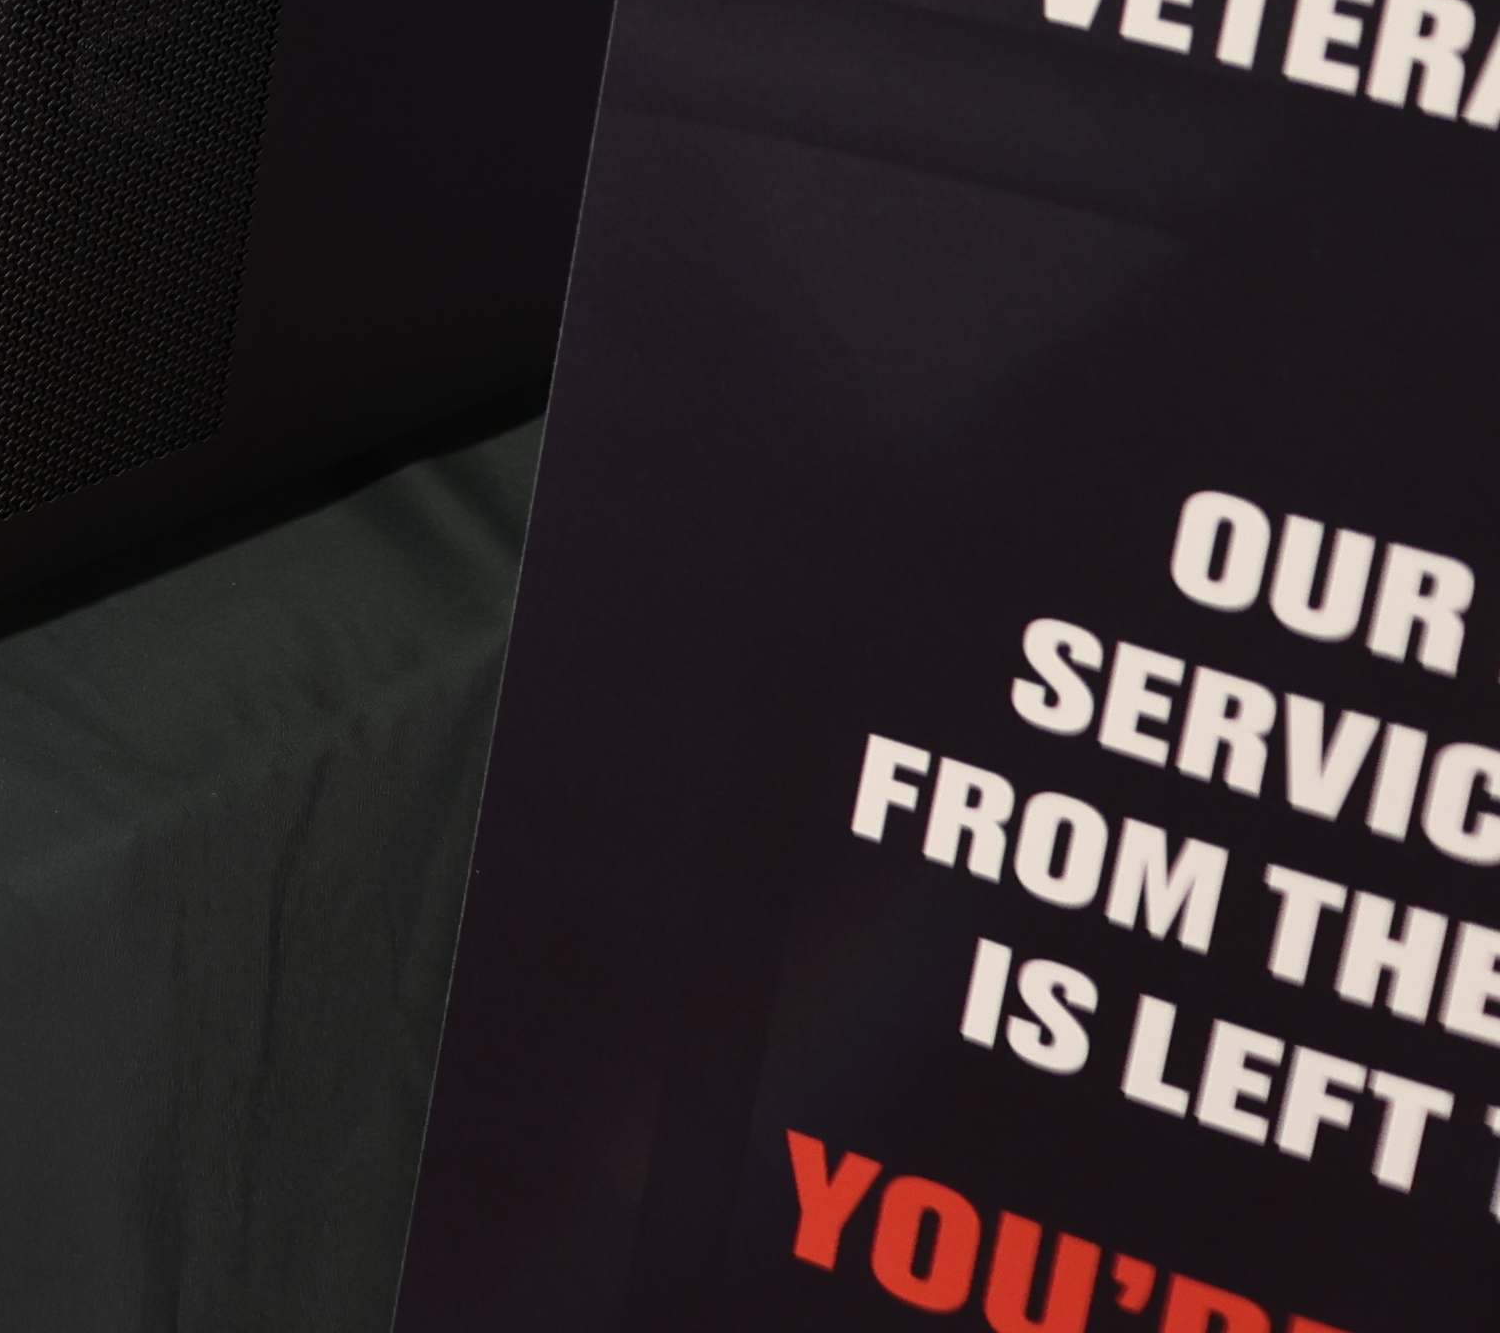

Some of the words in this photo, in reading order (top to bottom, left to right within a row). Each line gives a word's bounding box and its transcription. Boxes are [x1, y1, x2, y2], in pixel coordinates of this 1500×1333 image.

[1169, 489, 1476, 678] OUR
[850, 733, 1230, 956] FROM
[1010, 617, 1500, 867] SERVIC
[959, 936, 1100, 1075] IS
[1120, 993, 1456, 1194] LEFT
